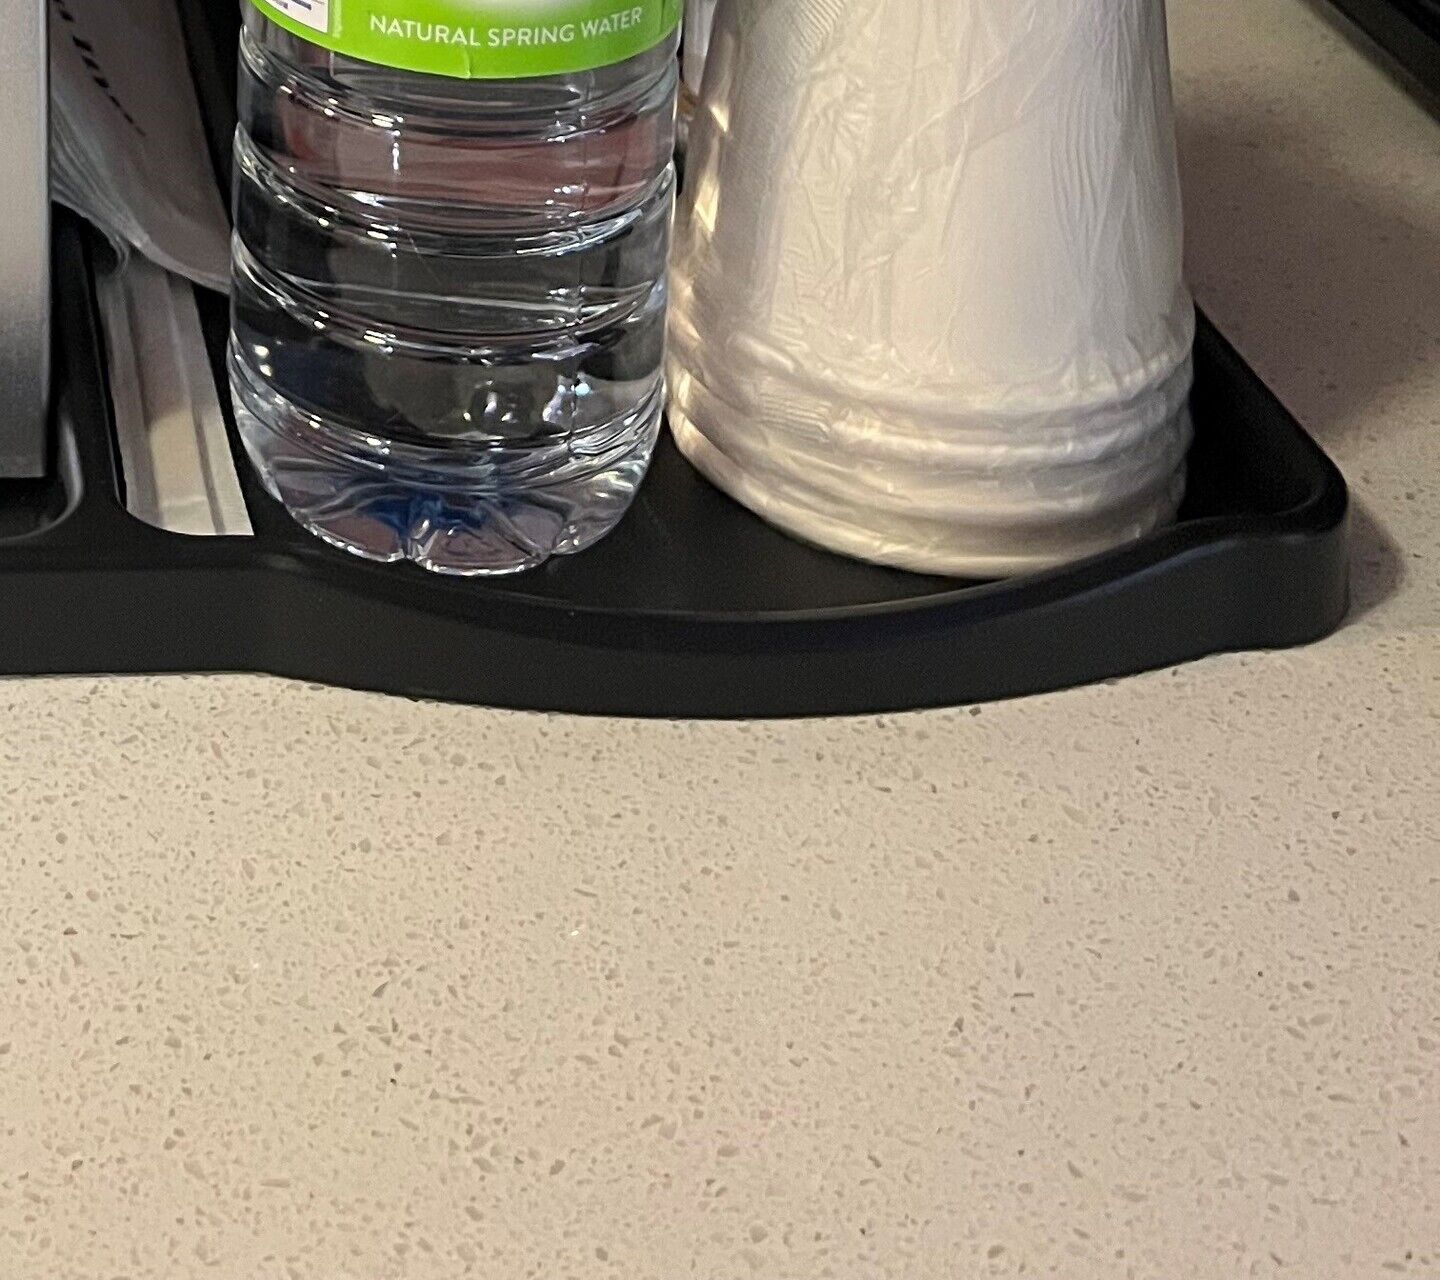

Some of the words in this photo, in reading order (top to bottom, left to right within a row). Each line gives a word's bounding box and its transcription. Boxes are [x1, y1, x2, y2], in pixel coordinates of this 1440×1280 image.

[370, 15, 481, 47] NATURAL
[488, 23, 575, 48] SPRING
[581, 6, 643, 39] WATER
